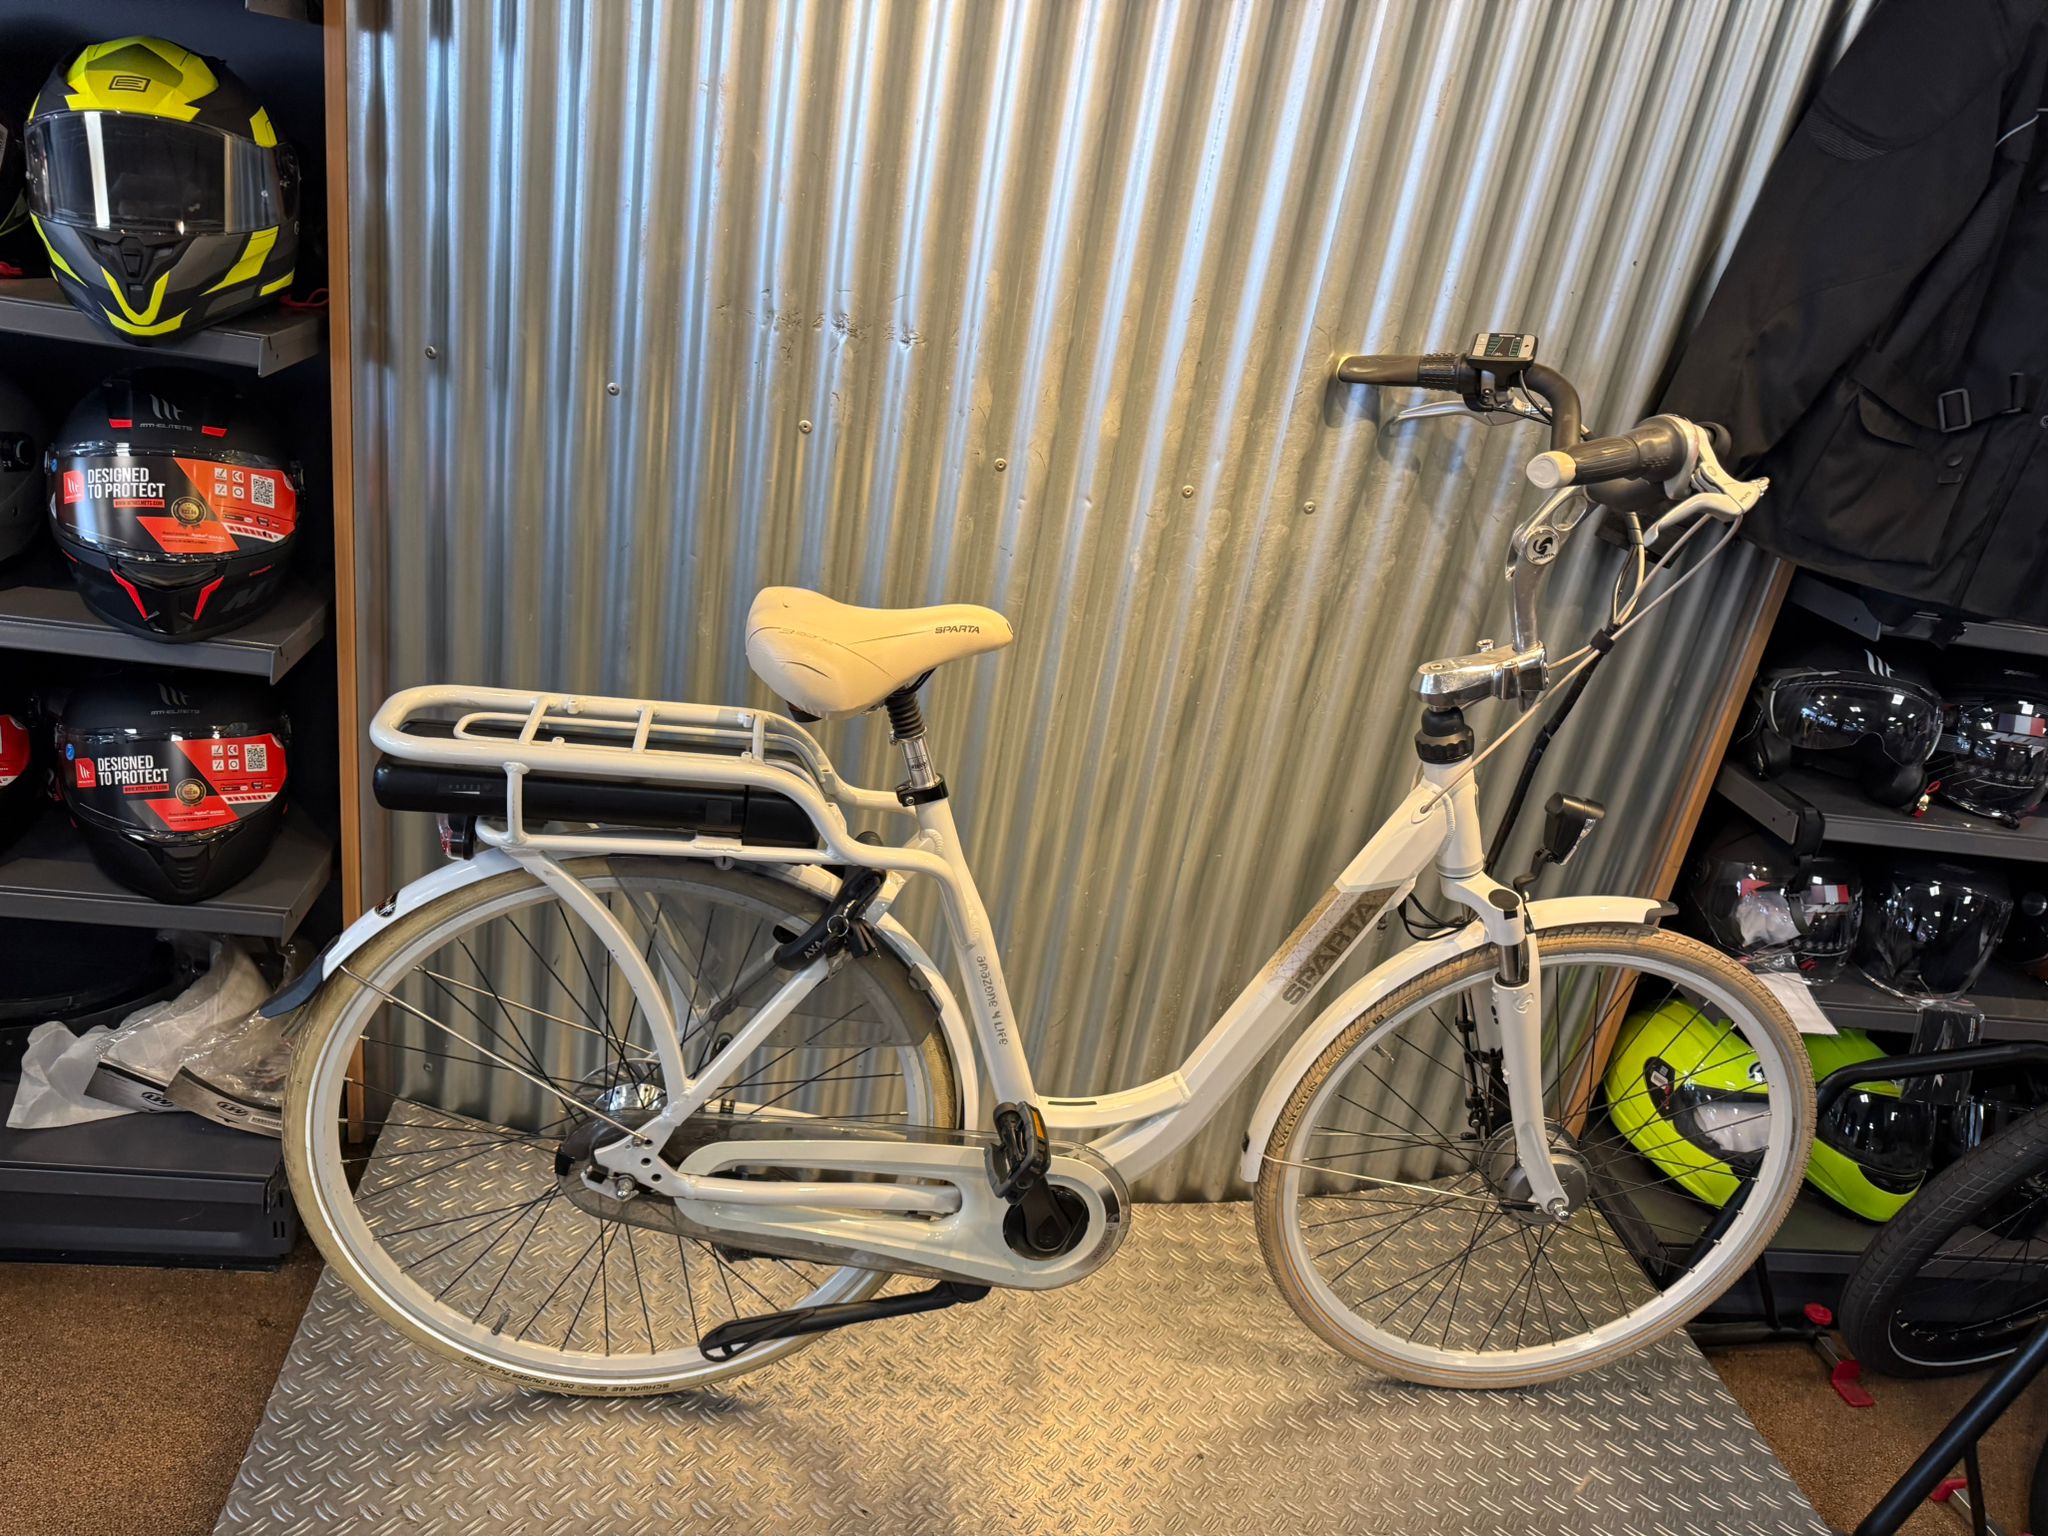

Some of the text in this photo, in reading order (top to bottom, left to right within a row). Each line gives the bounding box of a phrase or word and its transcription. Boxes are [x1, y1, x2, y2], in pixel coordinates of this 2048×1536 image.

[87, 467, 149, 484] DESIGNED
[87, 482, 166, 500] TO PROTECT
[934, 624, 981, 635] SPARTA
[97, 755, 154, 772] DESIGNED
[98, 768, 169, 786] TO PROTECT
[804, 941, 822, 959] AXA
[1282, 903, 1380, 1006] SPARTA
[976, 955, 998, 1008] amazone
[991, 1010, 1001, 1019] 4
[1325, 1045, 1350, 1069] ACTIVE
[1350, 1024, 1371, 1043] TOUR
[487, 1365, 511, 1376] PLUS
[511, 1373, 547, 1385] CRUISER
[548, 1381, 575, 1389] DELTA
[611, 1383, 670, 1392] SCHWALBE
